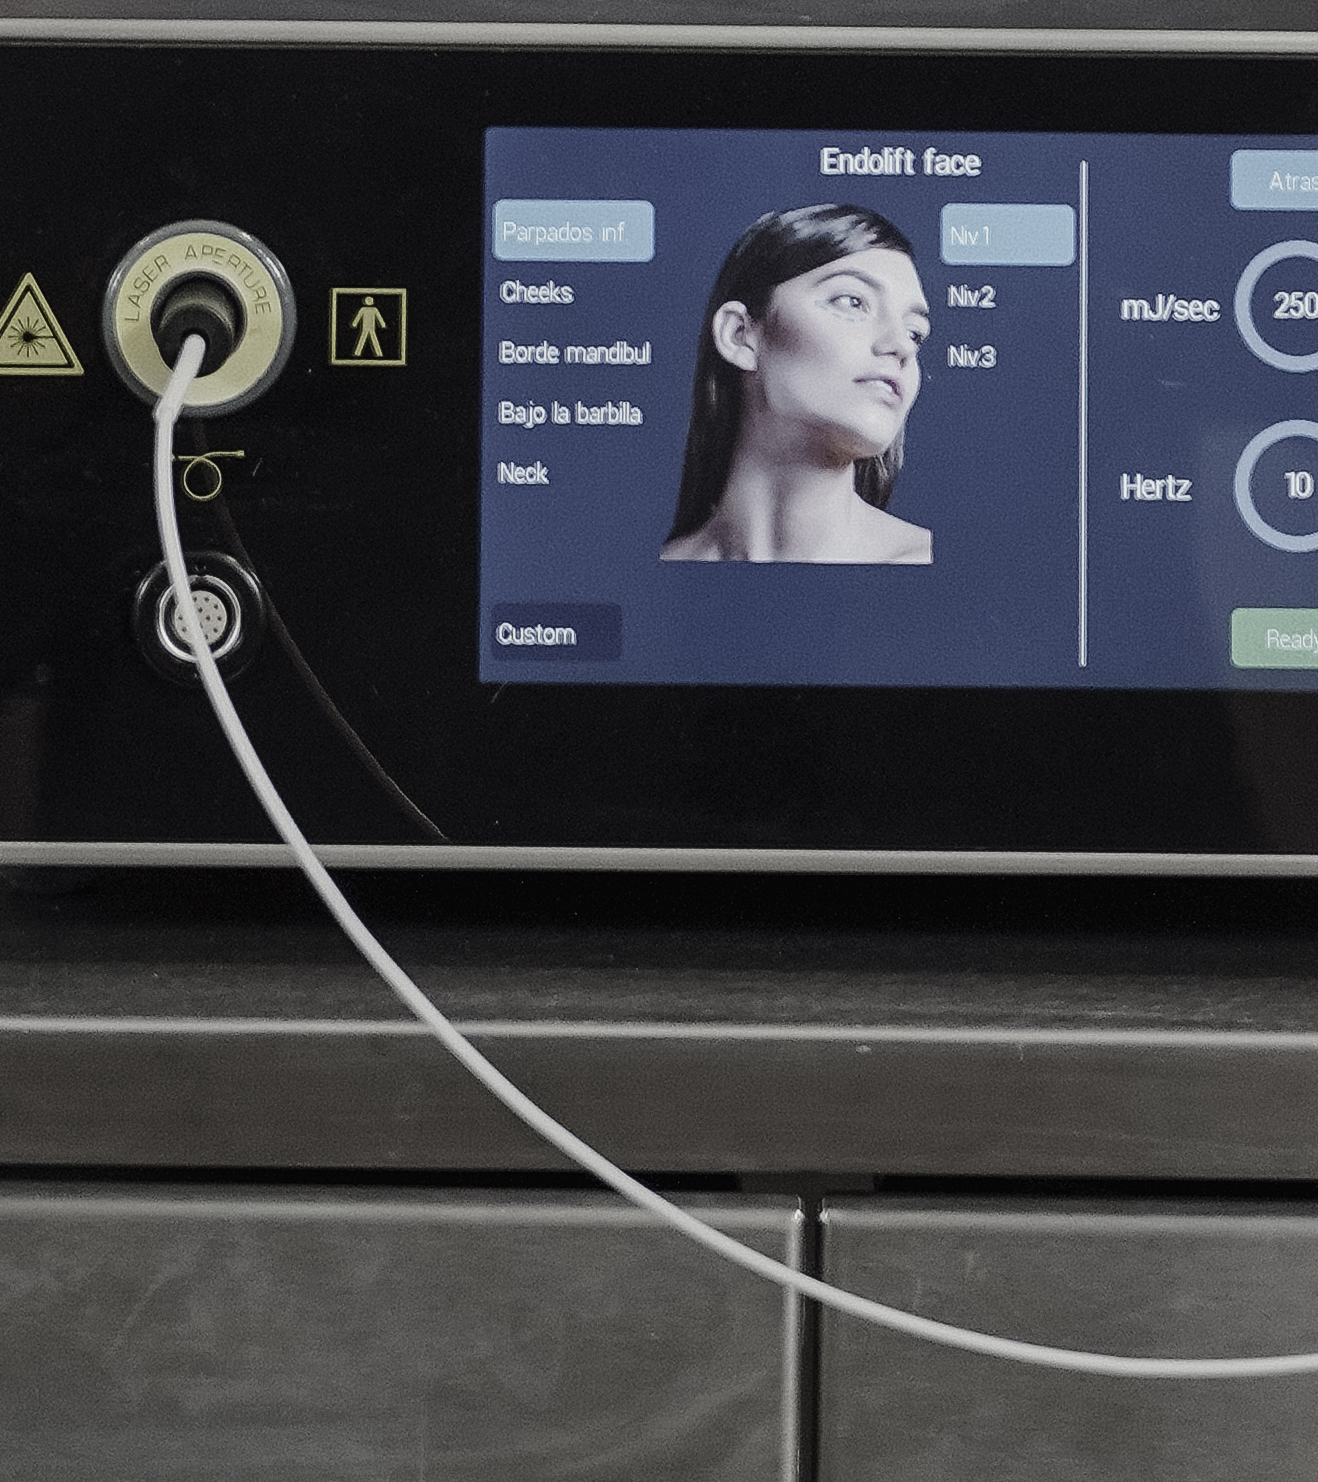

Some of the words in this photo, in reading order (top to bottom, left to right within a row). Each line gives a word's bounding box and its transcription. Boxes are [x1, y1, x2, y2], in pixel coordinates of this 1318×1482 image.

[819, 146, 915, 176] Endolift
[922, 146, 983, 177] face
[502, 221, 593, 246] Parpados
[124, 254, 172, 323] LASER
[184, 244, 272, 315] APERTURE
[499, 280, 576, 305] Cheeks
[946, 284, 997, 309] Niv2
[1119, 293, 1221, 322] mJ/sec
[498, 340, 560, 365] Borde
[564, 341, 652, 365] mandibul
[946, 344, 998, 369] Niv3
[497, 400, 547, 429] Bajo
[551, 401, 571, 425] la
[575, 401, 644, 426] barbilla
[496, 460, 550, 486] Neck
[1283, 471, 1315, 500] 10
[1119, 473, 1193, 502] Hertz
[495, 621, 578, 646] Custom
